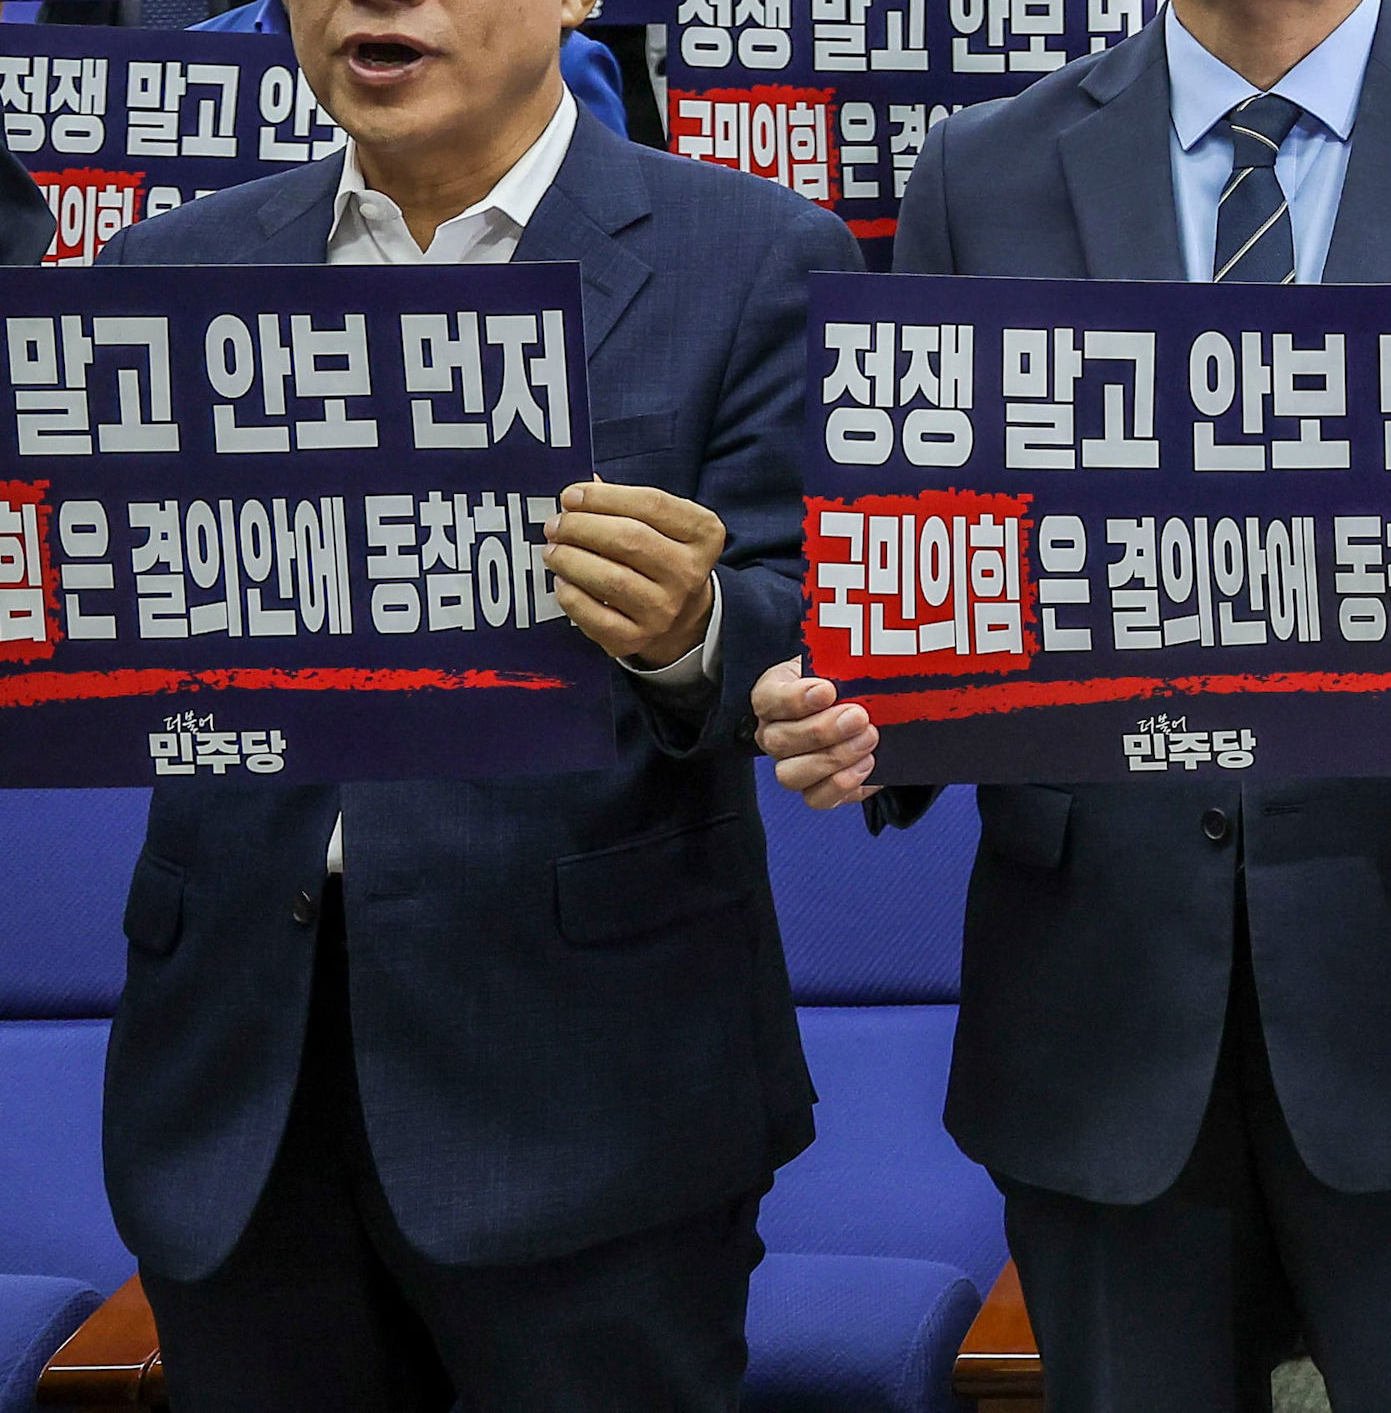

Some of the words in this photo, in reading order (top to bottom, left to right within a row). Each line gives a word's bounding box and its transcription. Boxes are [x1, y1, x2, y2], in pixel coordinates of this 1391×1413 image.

[0, 56, 108, 154] 정쟁
[127, 60, 240, 157] 말고
[840, 101, 880, 199] 은
[6, 315, 181, 456] 말고
[205, 313, 379, 454] 안보
[401, 310, 572, 449] 먼저
[822, 322, 975, 468] 정쟁
[1003, 327, 1160, 470] 말고
[1188, 330, 1352, 472] 안보
[59, 499, 117, 640] 은
[130, 495, 353, 639] 결의안에
[817, 510, 1025, 658] 국민의힘
[1039, 514, 1093, 652] 은
[1105, 514, 1321, 650] 결의안에
[149, 729, 288, 777] 민주당
[163, 712, 215, 734] 더불어
[1121, 728, 1257, 773] 민주당
[1136, 714, 1188, 735] 더불어
